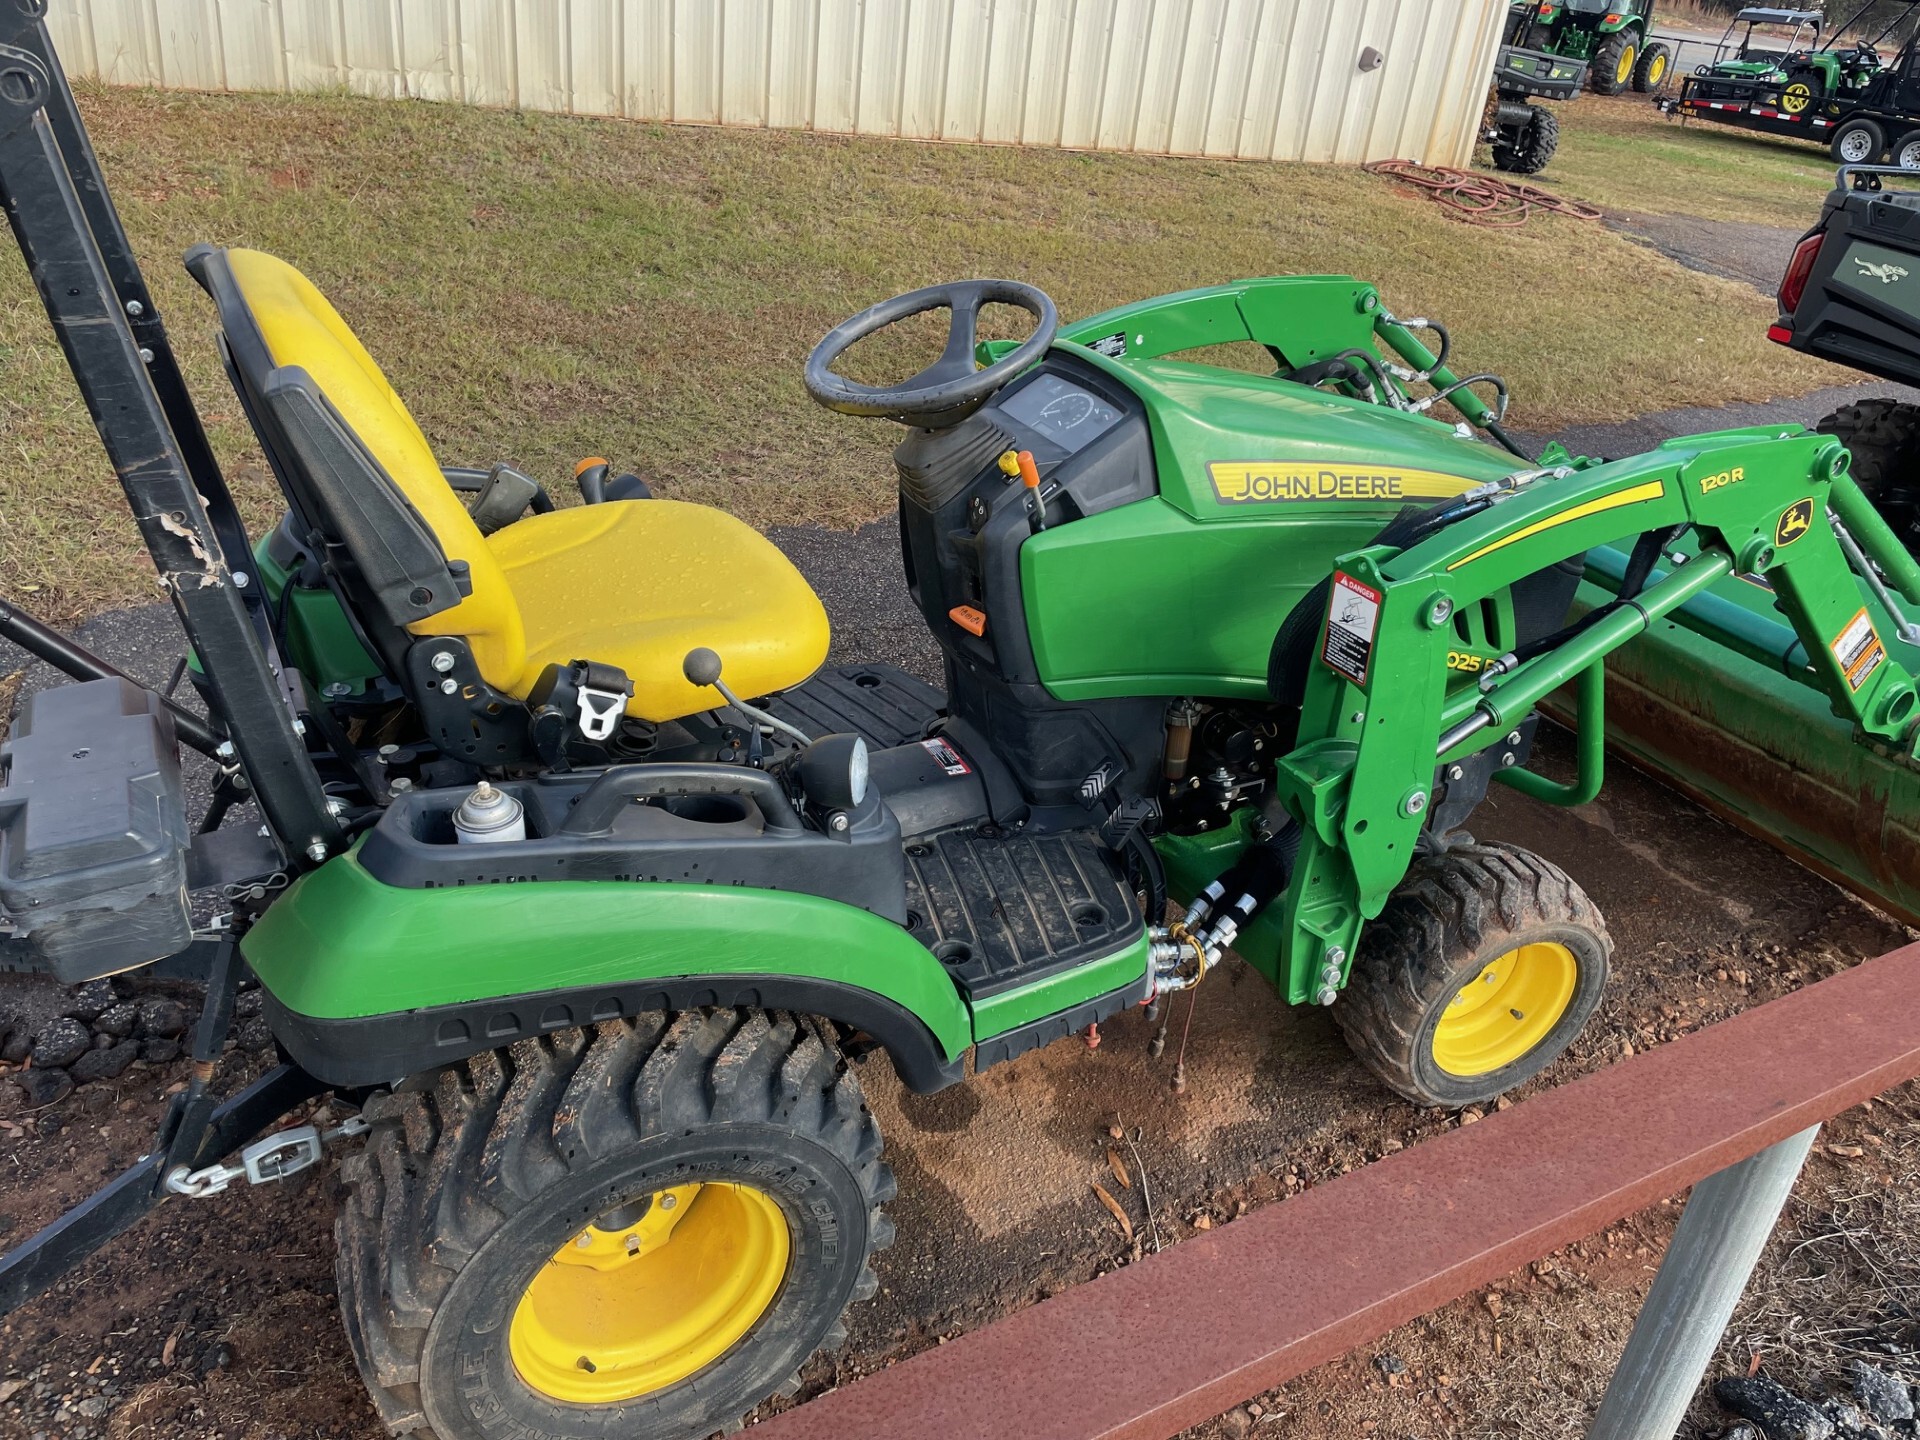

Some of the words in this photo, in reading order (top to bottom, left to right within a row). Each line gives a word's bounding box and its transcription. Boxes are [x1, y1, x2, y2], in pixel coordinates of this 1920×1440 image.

[1236, 472, 1310, 497] JOHN
[1318, 471, 1403, 496] DEERE
[1348, 581, 1375, 602] DANGER
[732, 1158, 813, 1193] TRAC
[808, 1197, 839, 1273] CHIEF
[461, 1344, 603, 1440] LISLE
